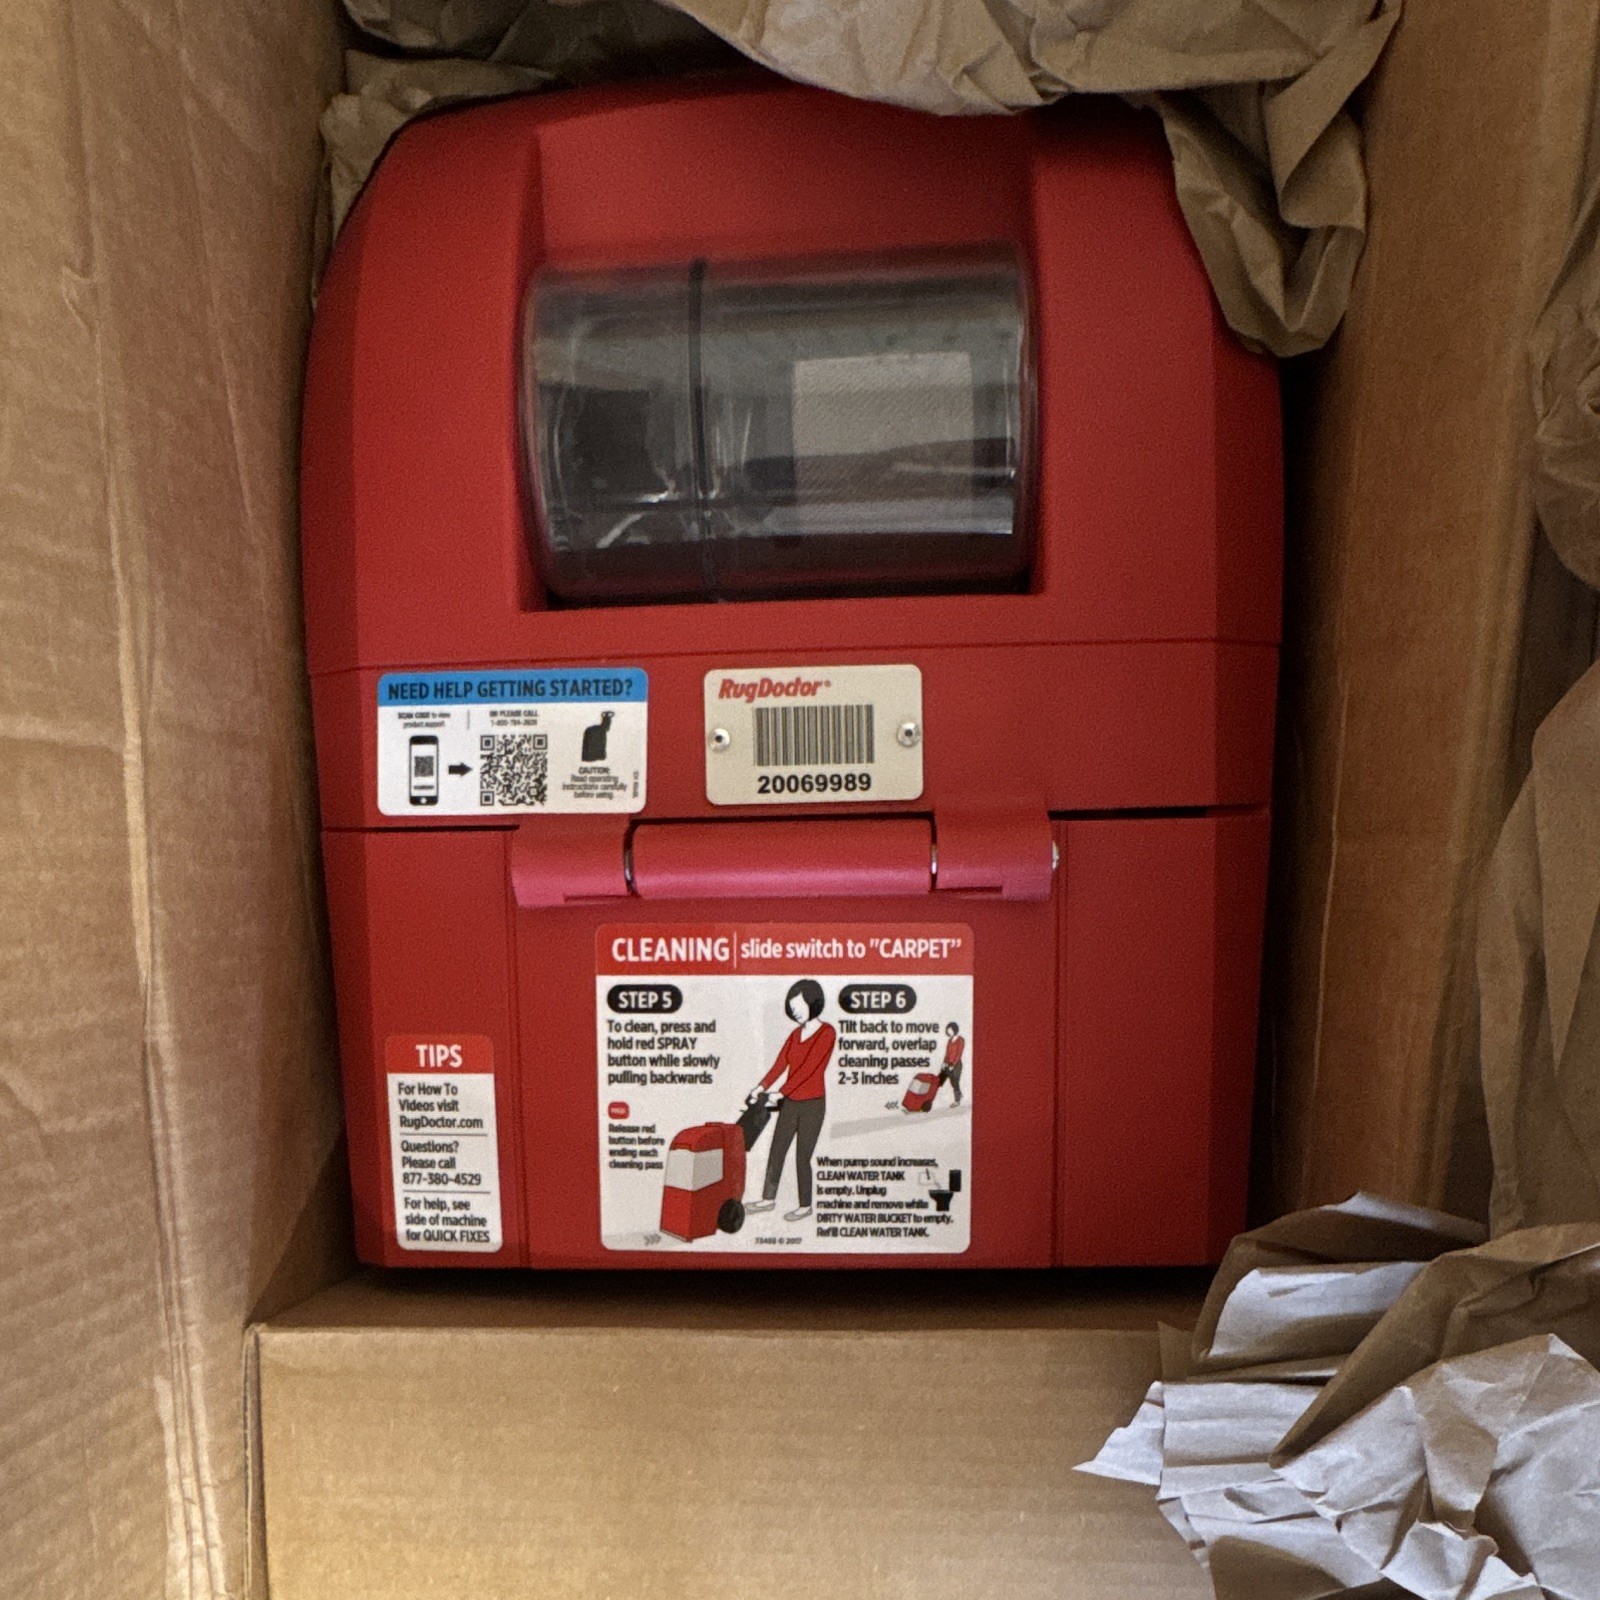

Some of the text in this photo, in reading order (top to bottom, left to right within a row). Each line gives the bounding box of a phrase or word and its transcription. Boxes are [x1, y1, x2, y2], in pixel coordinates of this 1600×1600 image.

[388, 678, 633, 700] NEED HELP GETTING STARTED?
[757, 773, 872, 794] 20069989
[611, 938, 730, 962] CLEANING
[741, 938, 782, 959] slide
[785, 938, 844, 959] switch
[847, 940, 866, 959] to
[618, 991, 672, 1009] STEP 5
[850, 991, 906, 1009] STEP 6
[607, 1019, 716, 1035] To clean, press and
[838, 1020, 939, 1033] Tilt back to move
[607, 1036, 697, 1050] hold red SPRAY
[838, 1037, 937, 1053] forward, overlap
[415, 1044, 463, 1068] TIPS
[607, 1053, 720, 1069] button while slowly
[838, 1054, 930, 1069] cleaning passes
[608, 1070, 713, 1086] pulling backwards
[838, 1070, 899, 1085] 2-3 inches
[398, 1082, 459, 1095] For How To
[398, 1099, 460, 1112] Videos visit
[399, 1115, 484, 1131] RugDoctor.com
[608, 1123, 656, 1133] Release red
[401, 1140, 460, 1153] Questions?
[608, 1135, 665, 1145] button before
[402, 1156, 456, 1169] Please call
[609, 1159, 643, 1170] cleaning
[817, 1157, 842, 1167] When
[843, 1158, 869, 1168] pump
[870, 1157, 897, 1167] sound
[403, 1172, 482, 1186] 877-380-4529
[817, 1171, 905, 1181] CLEAN WATER TANK
[825, 1186, 855, 1197] empty.
[856, 1186, 887, 1197] Unplug
[404, 1197, 470, 1212] For help, see
[817, 1199, 929, 1209] machine and remove while
[405, 1213, 488, 1227] side of machine
[817, 1213, 954, 1225] DIRTY WATER BUCKET to empty.
[406, 1229, 490, 1243] for QUICK FIXES
[840, 1227, 869, 1237] CLEAN
[869, 1227, 902, 1237] WATER
